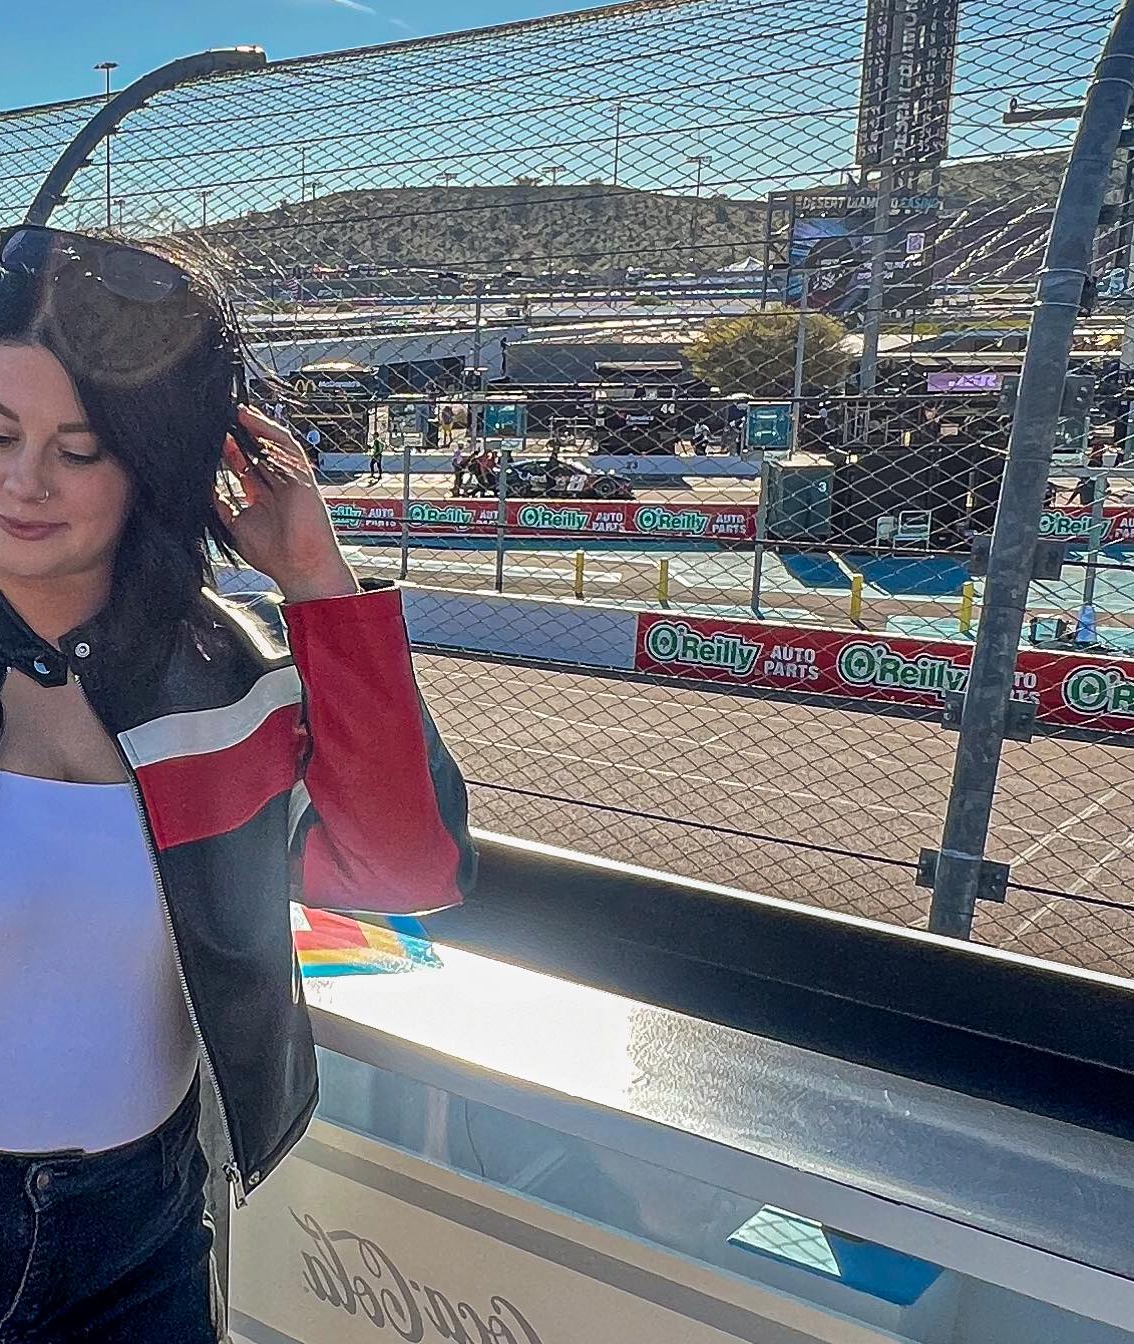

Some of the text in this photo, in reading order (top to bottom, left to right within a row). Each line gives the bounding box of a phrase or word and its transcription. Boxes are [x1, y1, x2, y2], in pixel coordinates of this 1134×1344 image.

[409, 505, 473, 529] O'Reilly
[522, 507, 588, 530] O'Reilly
[592, 522, 626, 532] PARTS
[595, 512, 624, 523] AUTO
[637, 508, 707, 534] O'Reilly
[715, 514, 745, 525] AUTO
[712, 524, 747, 535] PARTS
[651, 626, 756, 672] O'Reilly
[770, 644, 817, 665] AUTO
[764, 660, 820, 681] PARTS
[1013, 671, 1038, 689] TO
